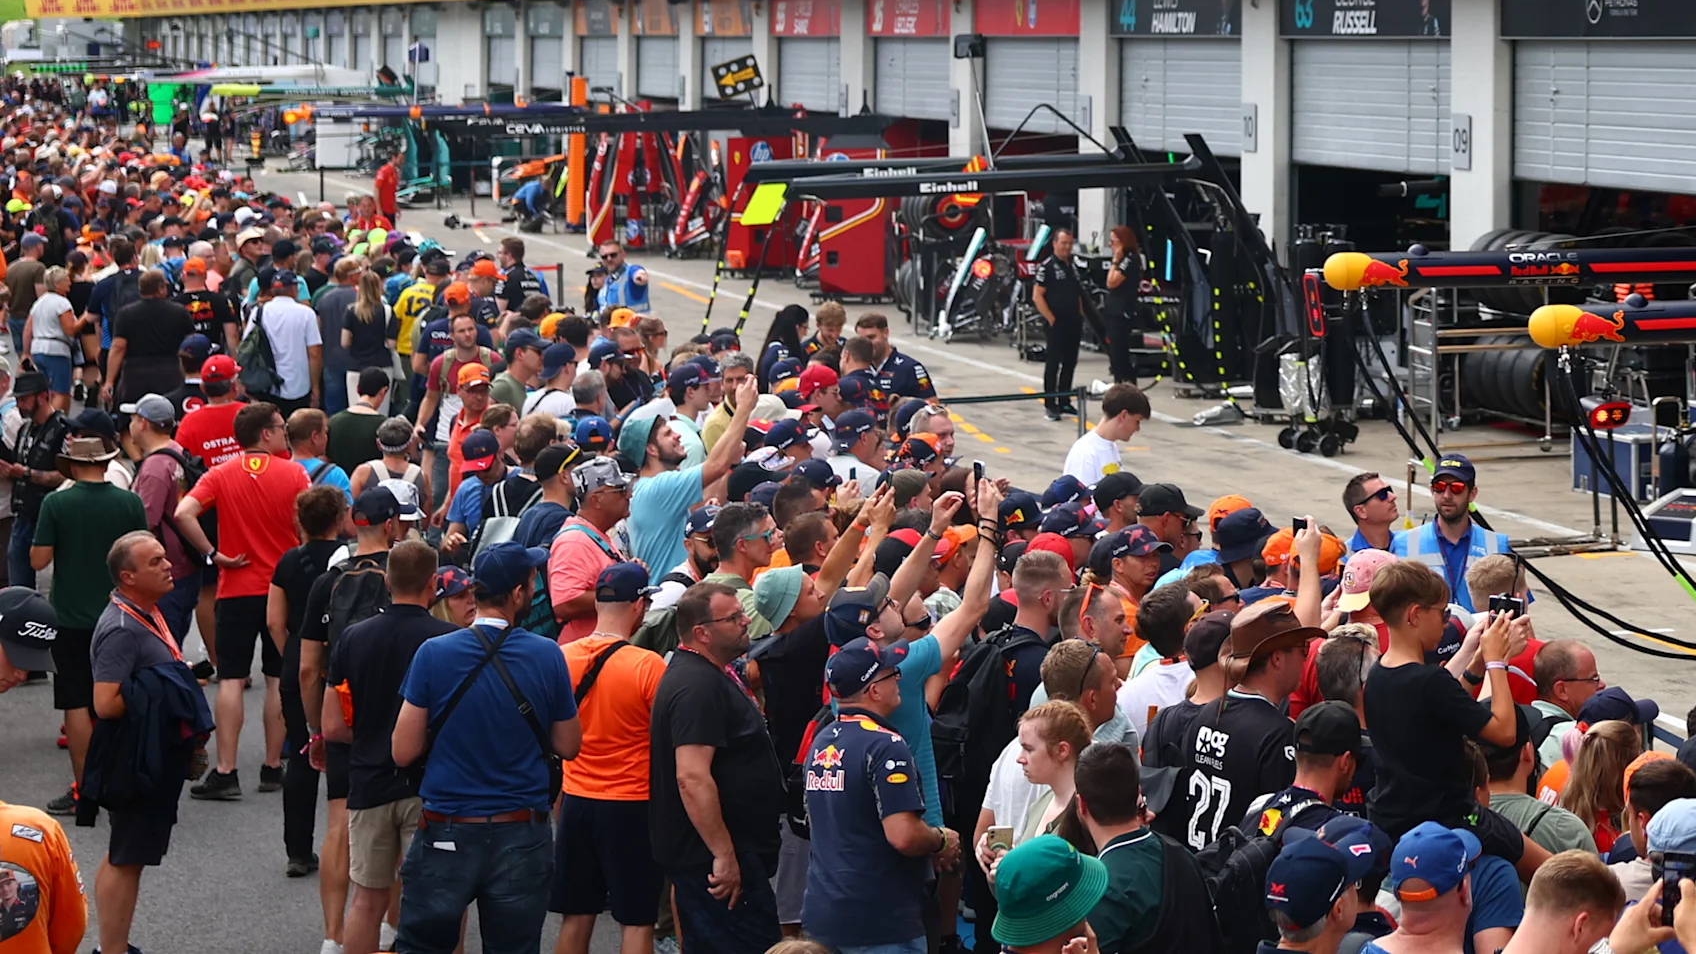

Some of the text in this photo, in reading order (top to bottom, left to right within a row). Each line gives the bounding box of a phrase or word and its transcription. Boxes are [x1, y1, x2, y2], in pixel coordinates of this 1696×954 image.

[1151, 11, 1196, 35] HAMILTON
[1332, 9, 1378, 35] RUSSELL
[1453, 128, 1468, 154] 09
[863, 167, 917, 178] Einhell
[919, 181, 979, 193] Einhell
[1509, 252, 1578, 264] ORACLE
[405, 296, 433, 317] 12
[1188, 769, 1232, 851] 27
